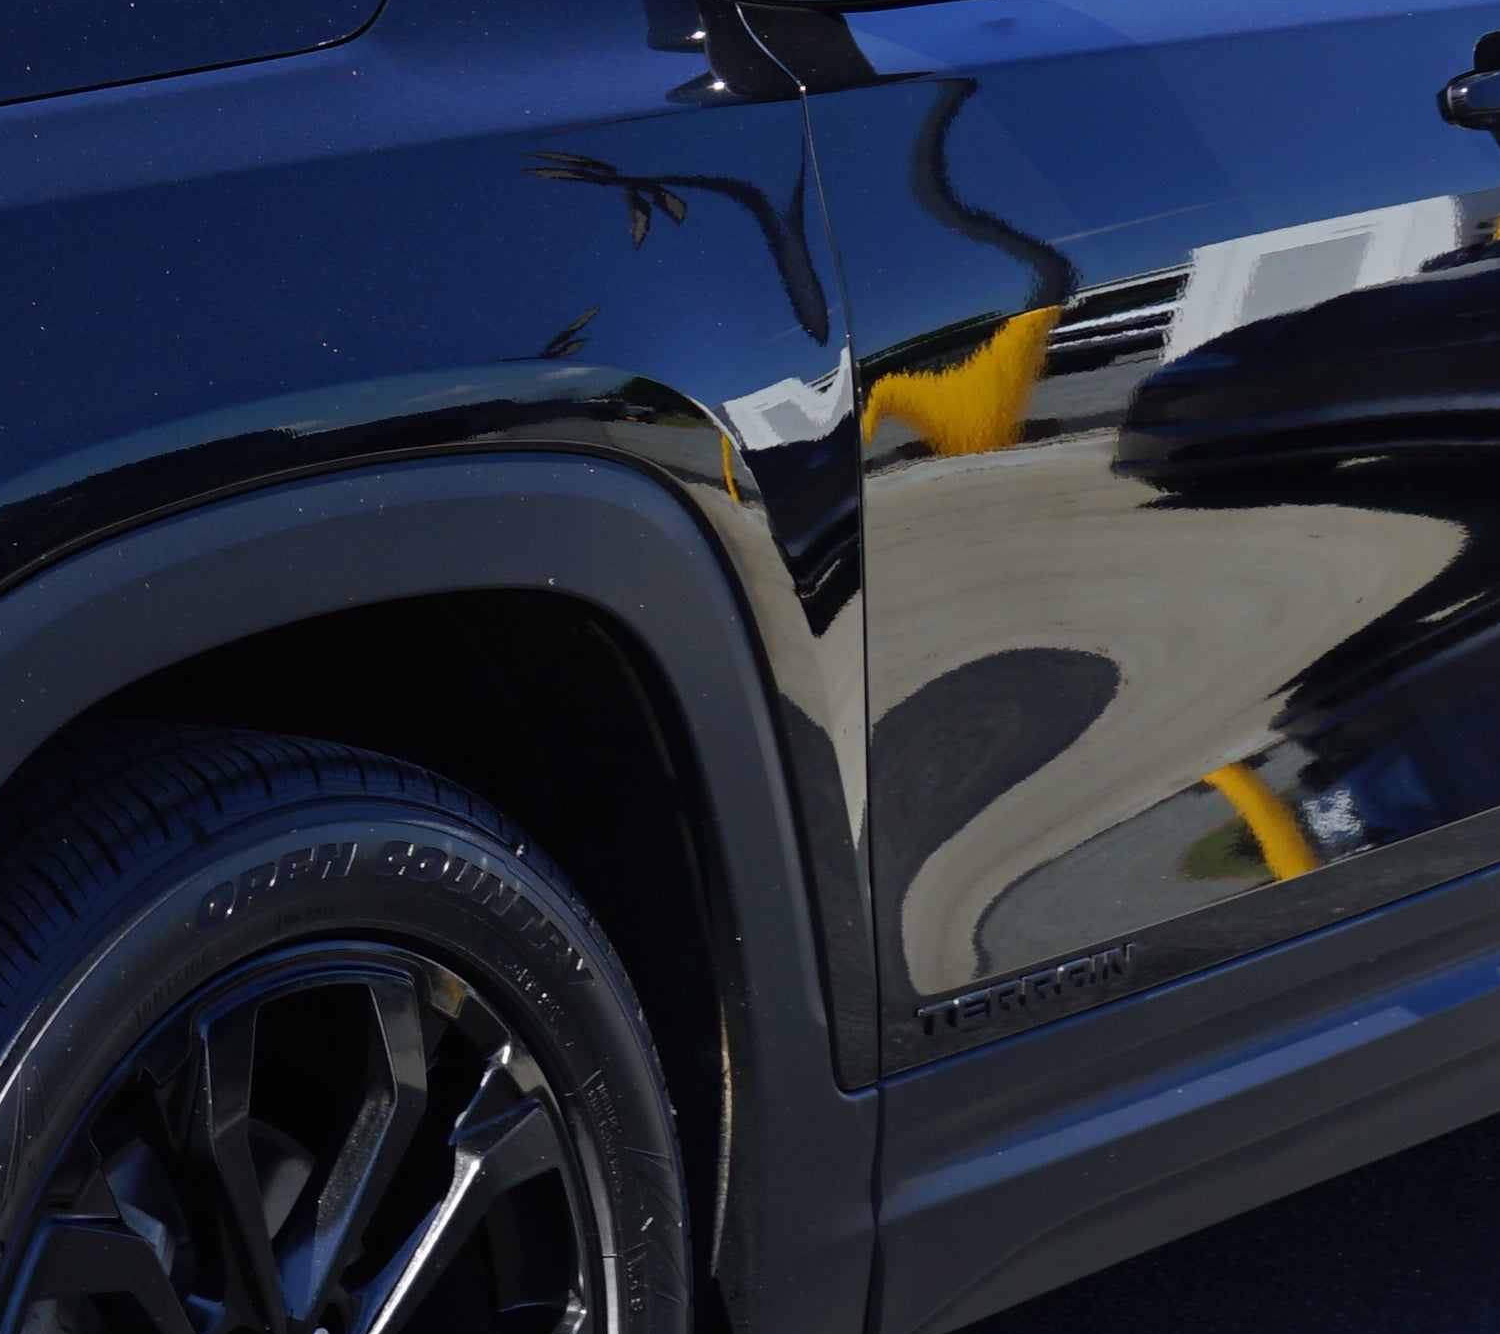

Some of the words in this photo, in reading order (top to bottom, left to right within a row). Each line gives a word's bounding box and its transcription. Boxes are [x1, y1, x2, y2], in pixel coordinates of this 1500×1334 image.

[197, 842, 359, 927] OPEN
[377, 842, 598, 985] COUNTRY
[915, 941, 1137, 1037] TERRAIN
